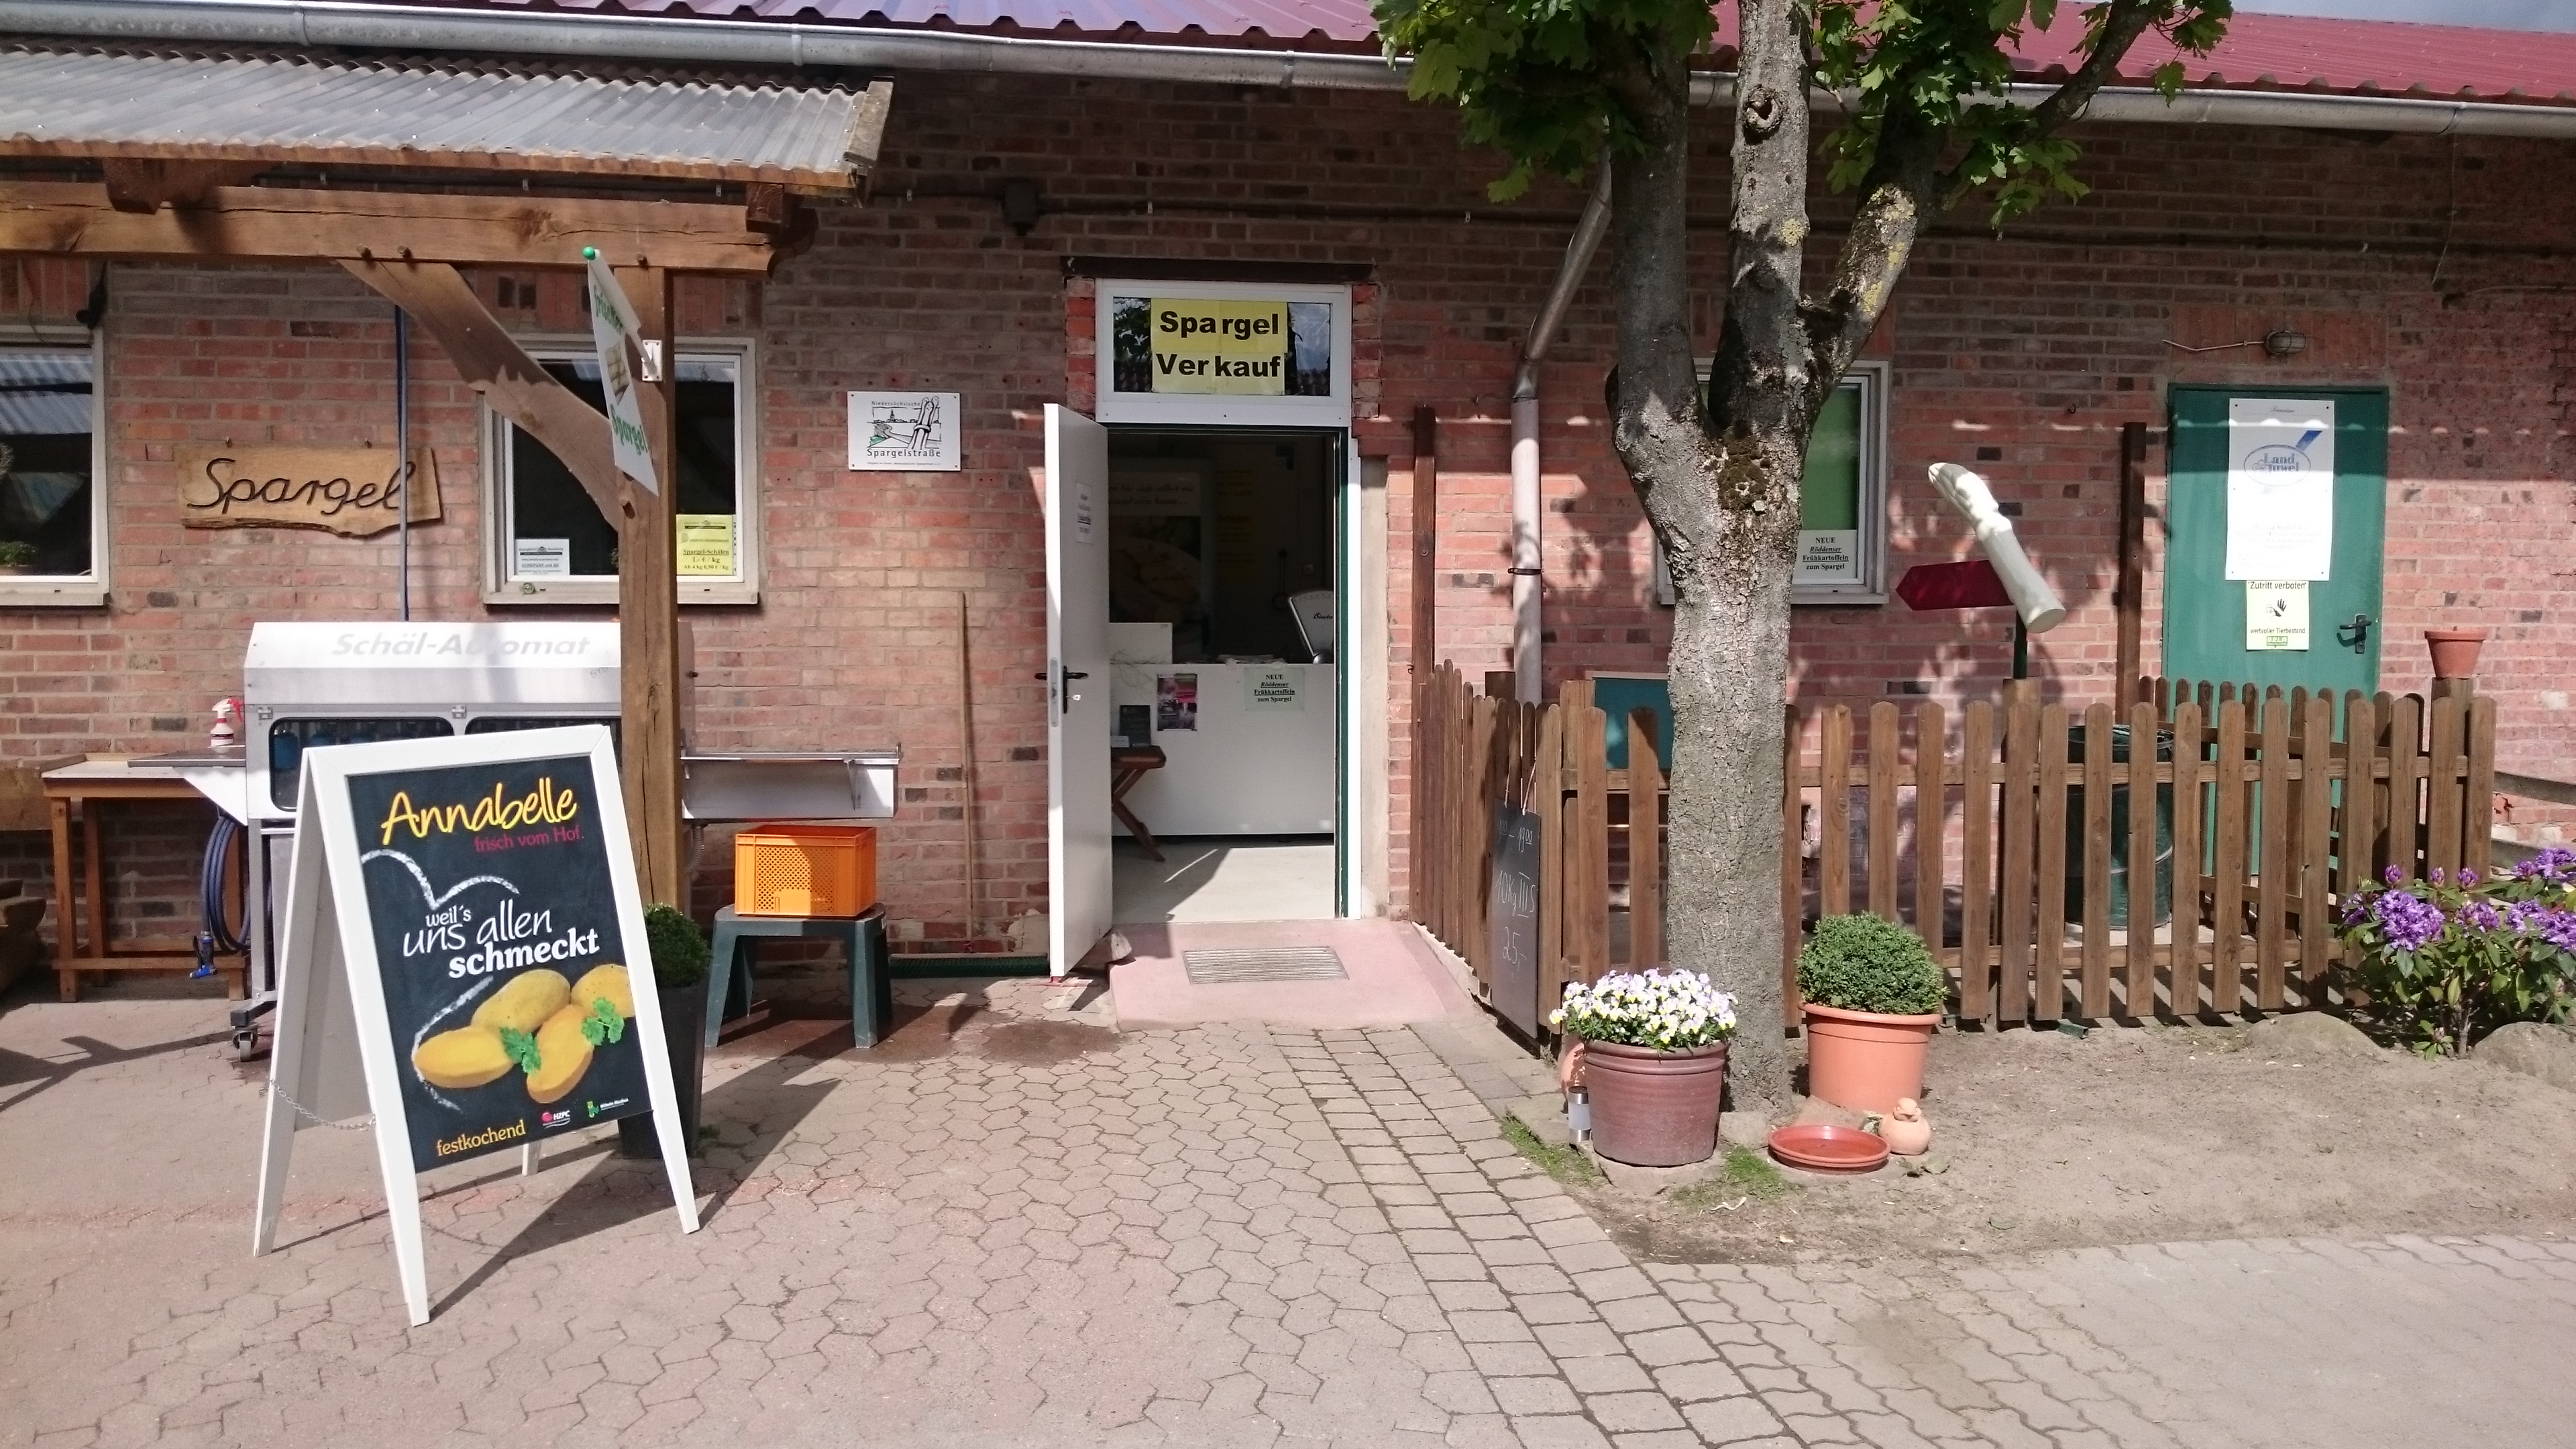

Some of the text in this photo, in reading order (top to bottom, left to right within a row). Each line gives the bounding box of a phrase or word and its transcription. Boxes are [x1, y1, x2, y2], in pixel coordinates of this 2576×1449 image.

[1159, 311, 1279, 341] Spargel
[867, 448, 941, 459] Spargelstraße
[2263, 453, 2295, 464] Land
[187, 458, 416, 515] Spargel
[1809, 545, 1841, 554] Röddenser
[1802, 554, 1849, 562] Frühkartoffeln
[1821, 563, 1845, 572] Spargel
[2249, 581, 2306, 590] Zutritt verboten
[380, 777, 578, 846] Annabelle
[474, 835, 515, 852] frisch
[517, 832, 550, 847] vom
[403, 899, 552, 957] uns allen
[449, 927, 600, 979] schmeckt
[553, 1110, 570, 1120] HZPC
[437, 1119, 526, 1157] festkochend
